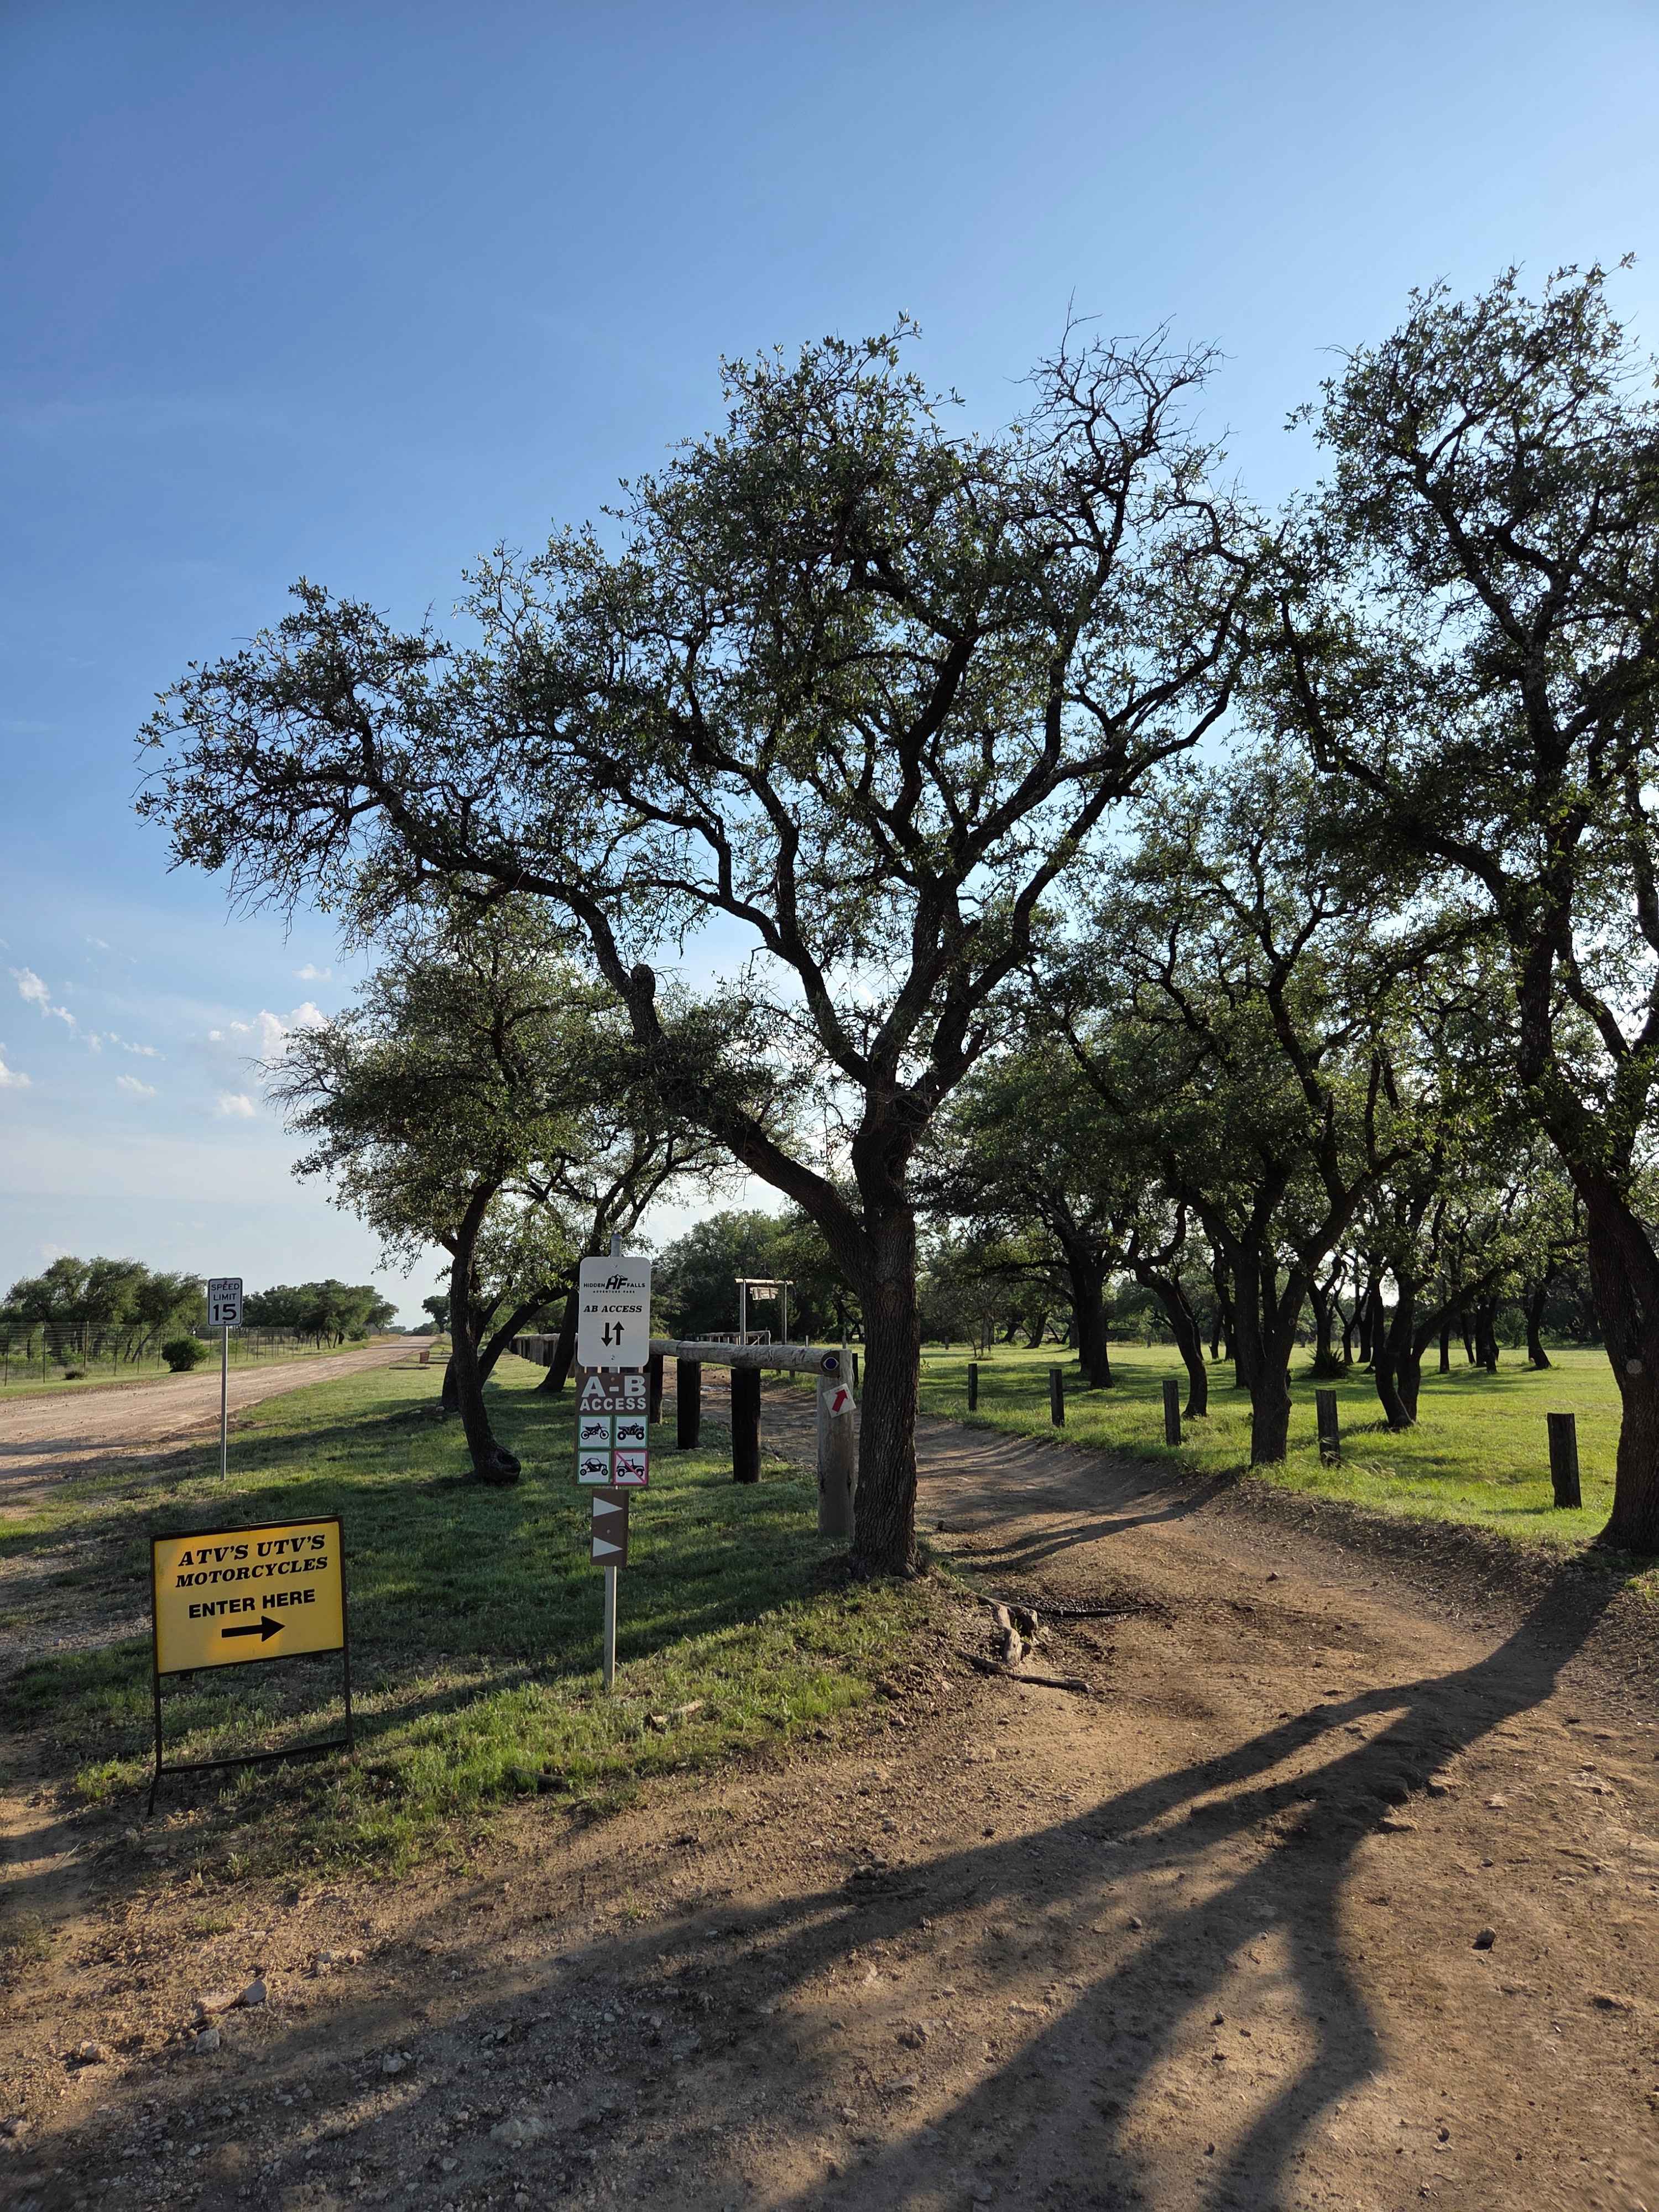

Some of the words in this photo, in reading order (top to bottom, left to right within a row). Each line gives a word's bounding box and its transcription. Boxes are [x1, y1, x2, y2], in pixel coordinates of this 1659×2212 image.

[213, 1303, 237, 1321] 15
[580, 1397, 646, 1411] ACCESS
[178, 1544, 248, 1566] ATV'S
[257, 1534, 325, 1557] UTV'S
[175, 1556, 328, 1587] MOTORCYCLES
[189, 1597, 255, 1619] ENTER
[262, 1589, 316, 1609] HERE
